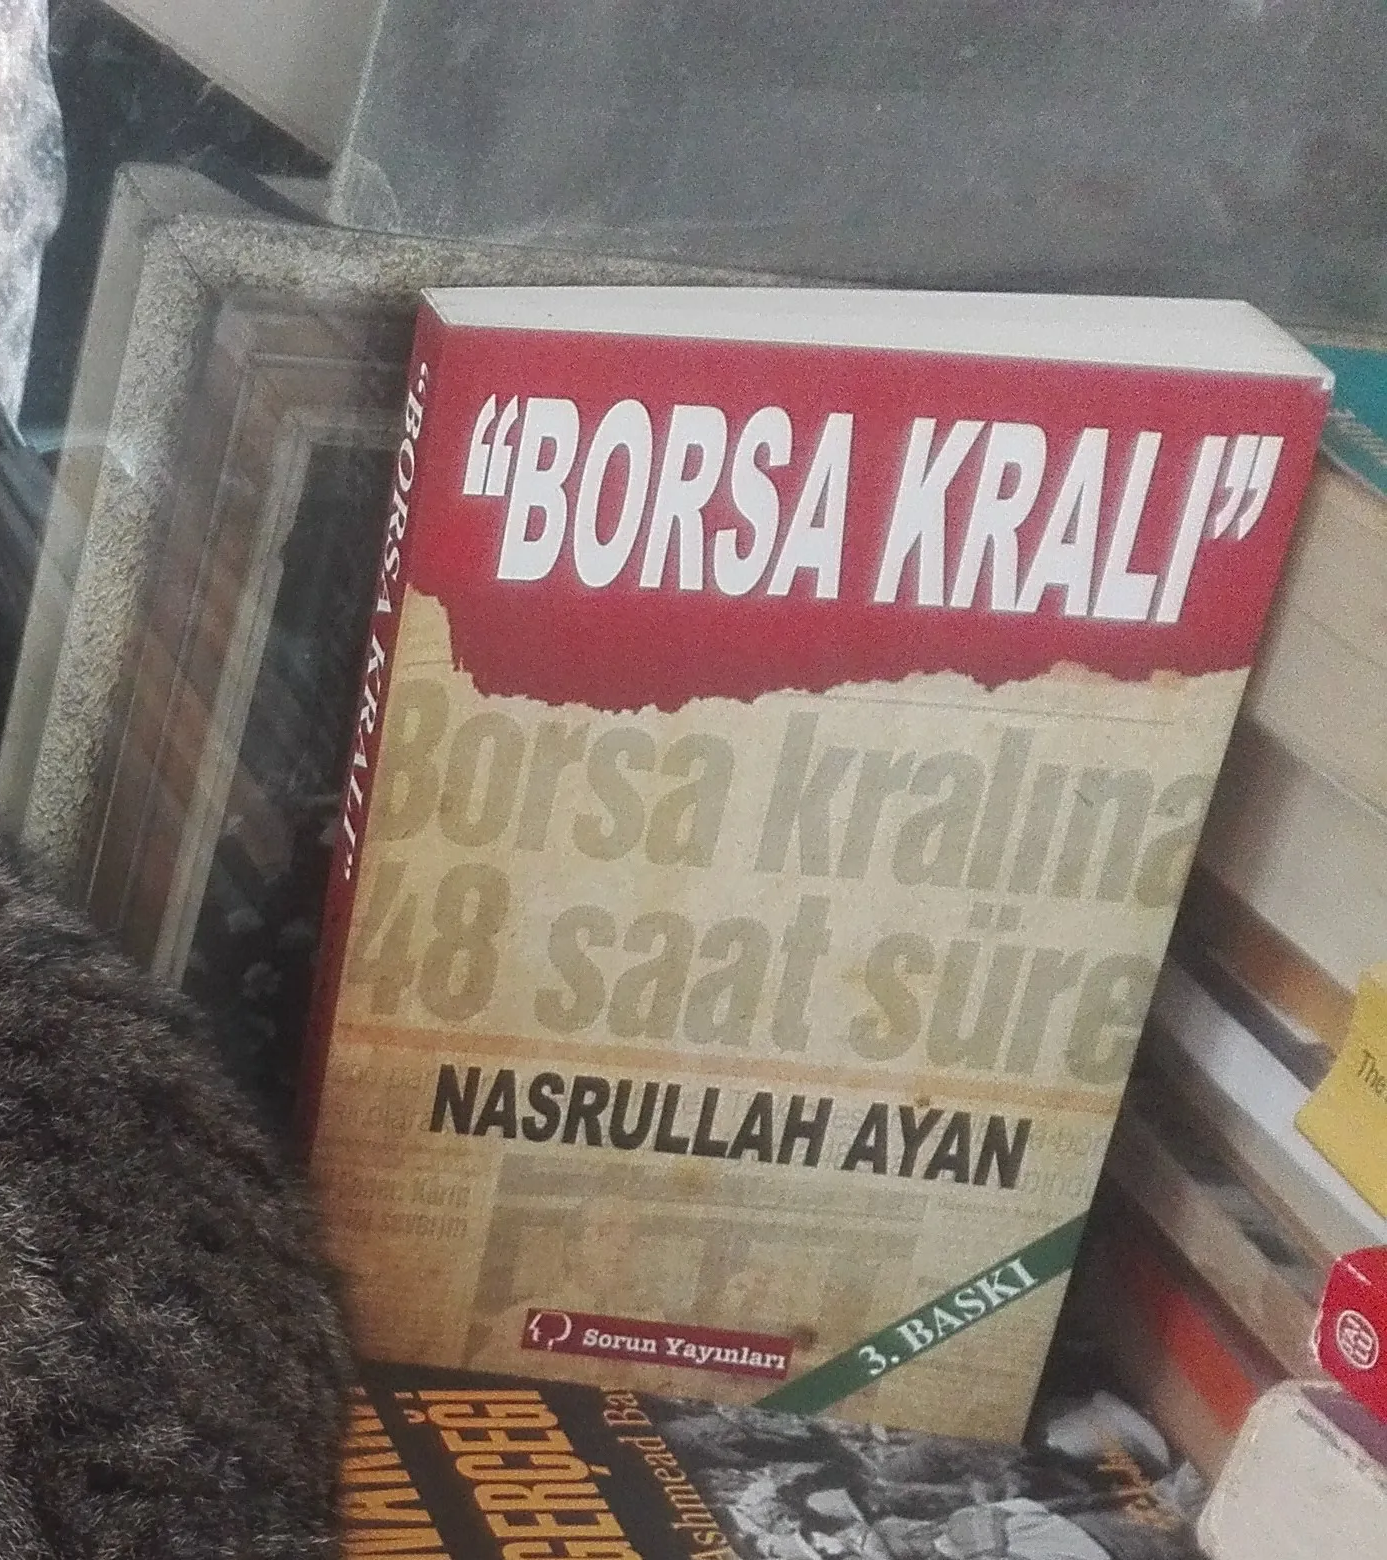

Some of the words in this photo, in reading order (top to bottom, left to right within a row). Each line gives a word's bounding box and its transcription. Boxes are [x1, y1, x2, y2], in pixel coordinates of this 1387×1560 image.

[368, 678, 737, 867] Borsa
[342, 862, 511, 1024] 48
[537, 897, 832, 1053] saat
[430, 1064, 833, 1167] NASRULLAH
[841, 1102, 1032, 1189] AYAN
[582, 1326, 657, 1355] Sorun
[665, 1333, 786, 1370] Yayınları
[856, 1346, 900, 1379] 3.
[897, 1258, 1038, 1355] BASKI
